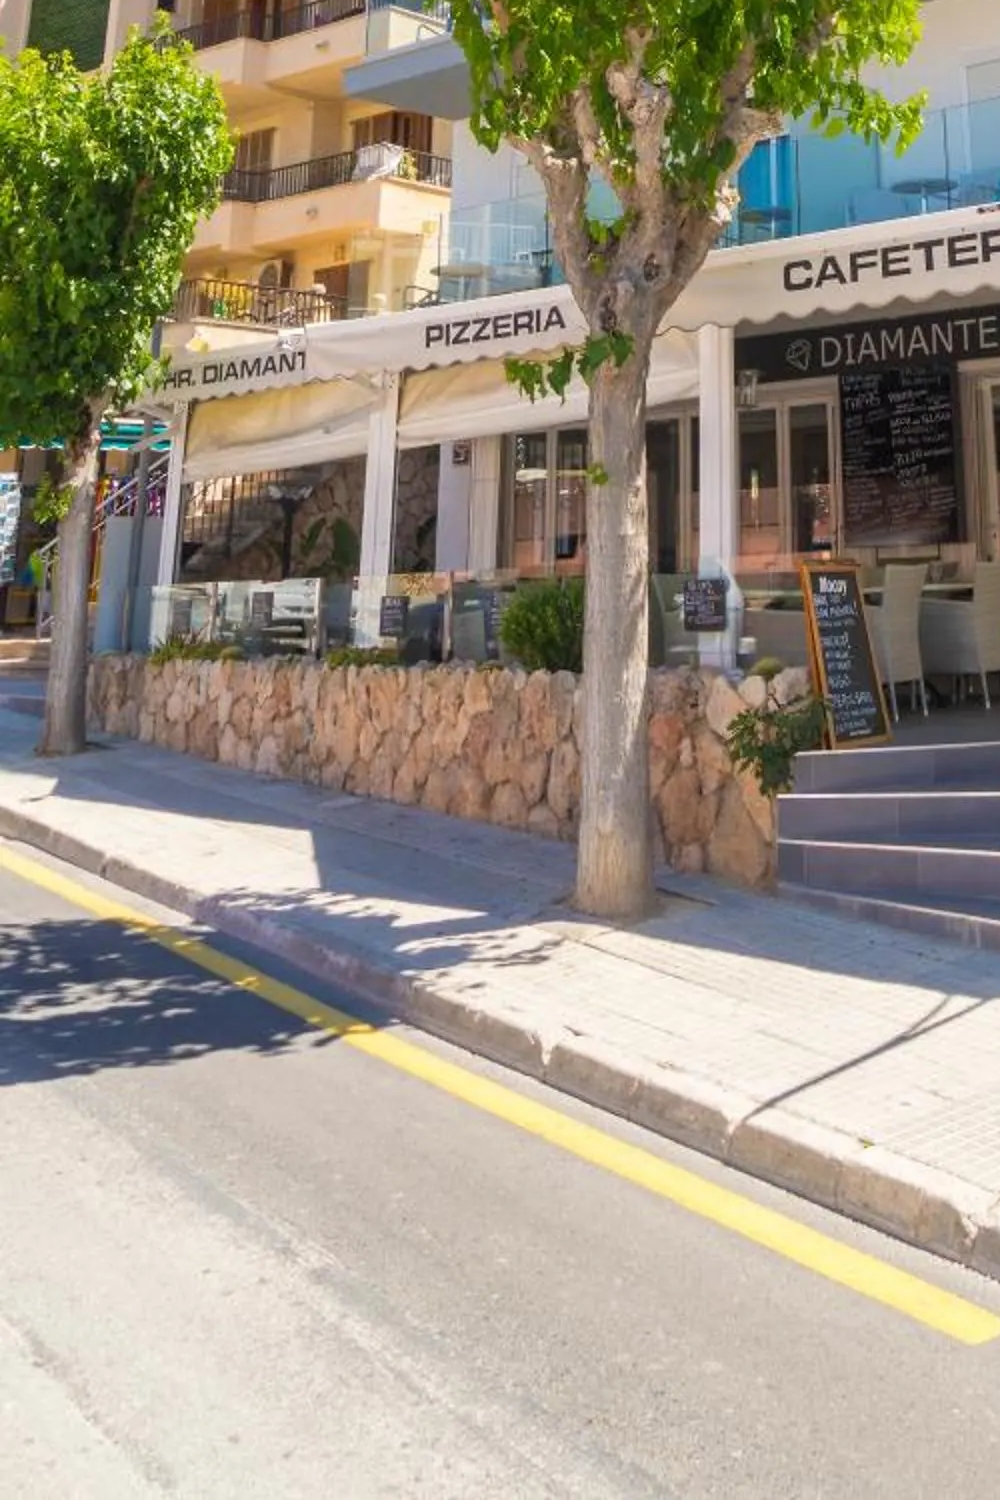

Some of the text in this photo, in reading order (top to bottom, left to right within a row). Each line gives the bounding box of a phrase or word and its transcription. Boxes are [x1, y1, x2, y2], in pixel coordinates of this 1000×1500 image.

[425, 305, 566, 348] PIZZERIA
[820, 316, 999, 368] DIAMANTE
[202, 351, 307, 385] DIAMANT
